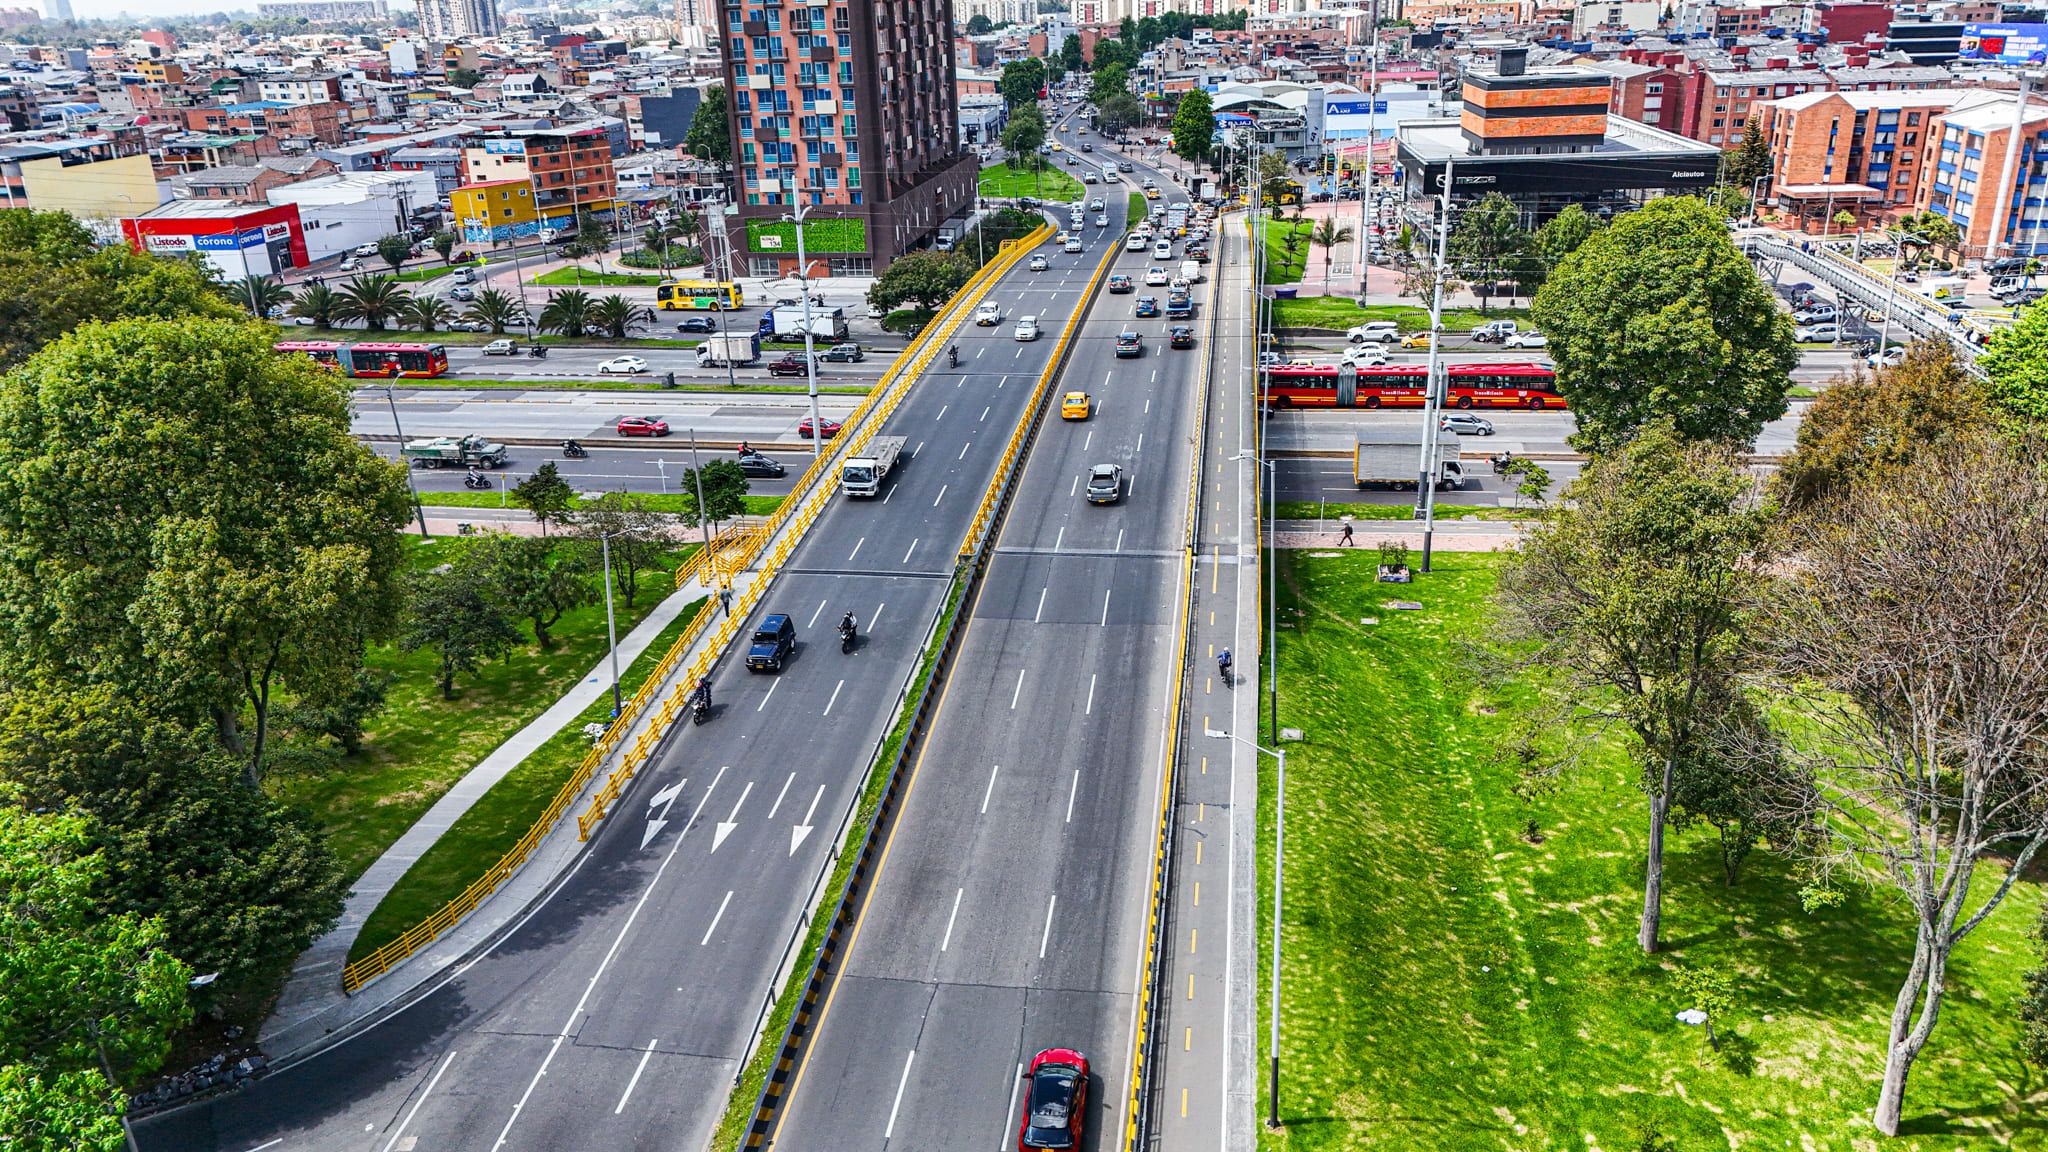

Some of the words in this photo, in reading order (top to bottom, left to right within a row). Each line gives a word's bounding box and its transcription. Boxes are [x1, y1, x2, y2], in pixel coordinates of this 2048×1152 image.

[266, 225, 286, 236] Listodo
[153, 237, 187, 246] Listodo
[198, 237, 234, 246] corona
[240, 233, 262, 243] corona
